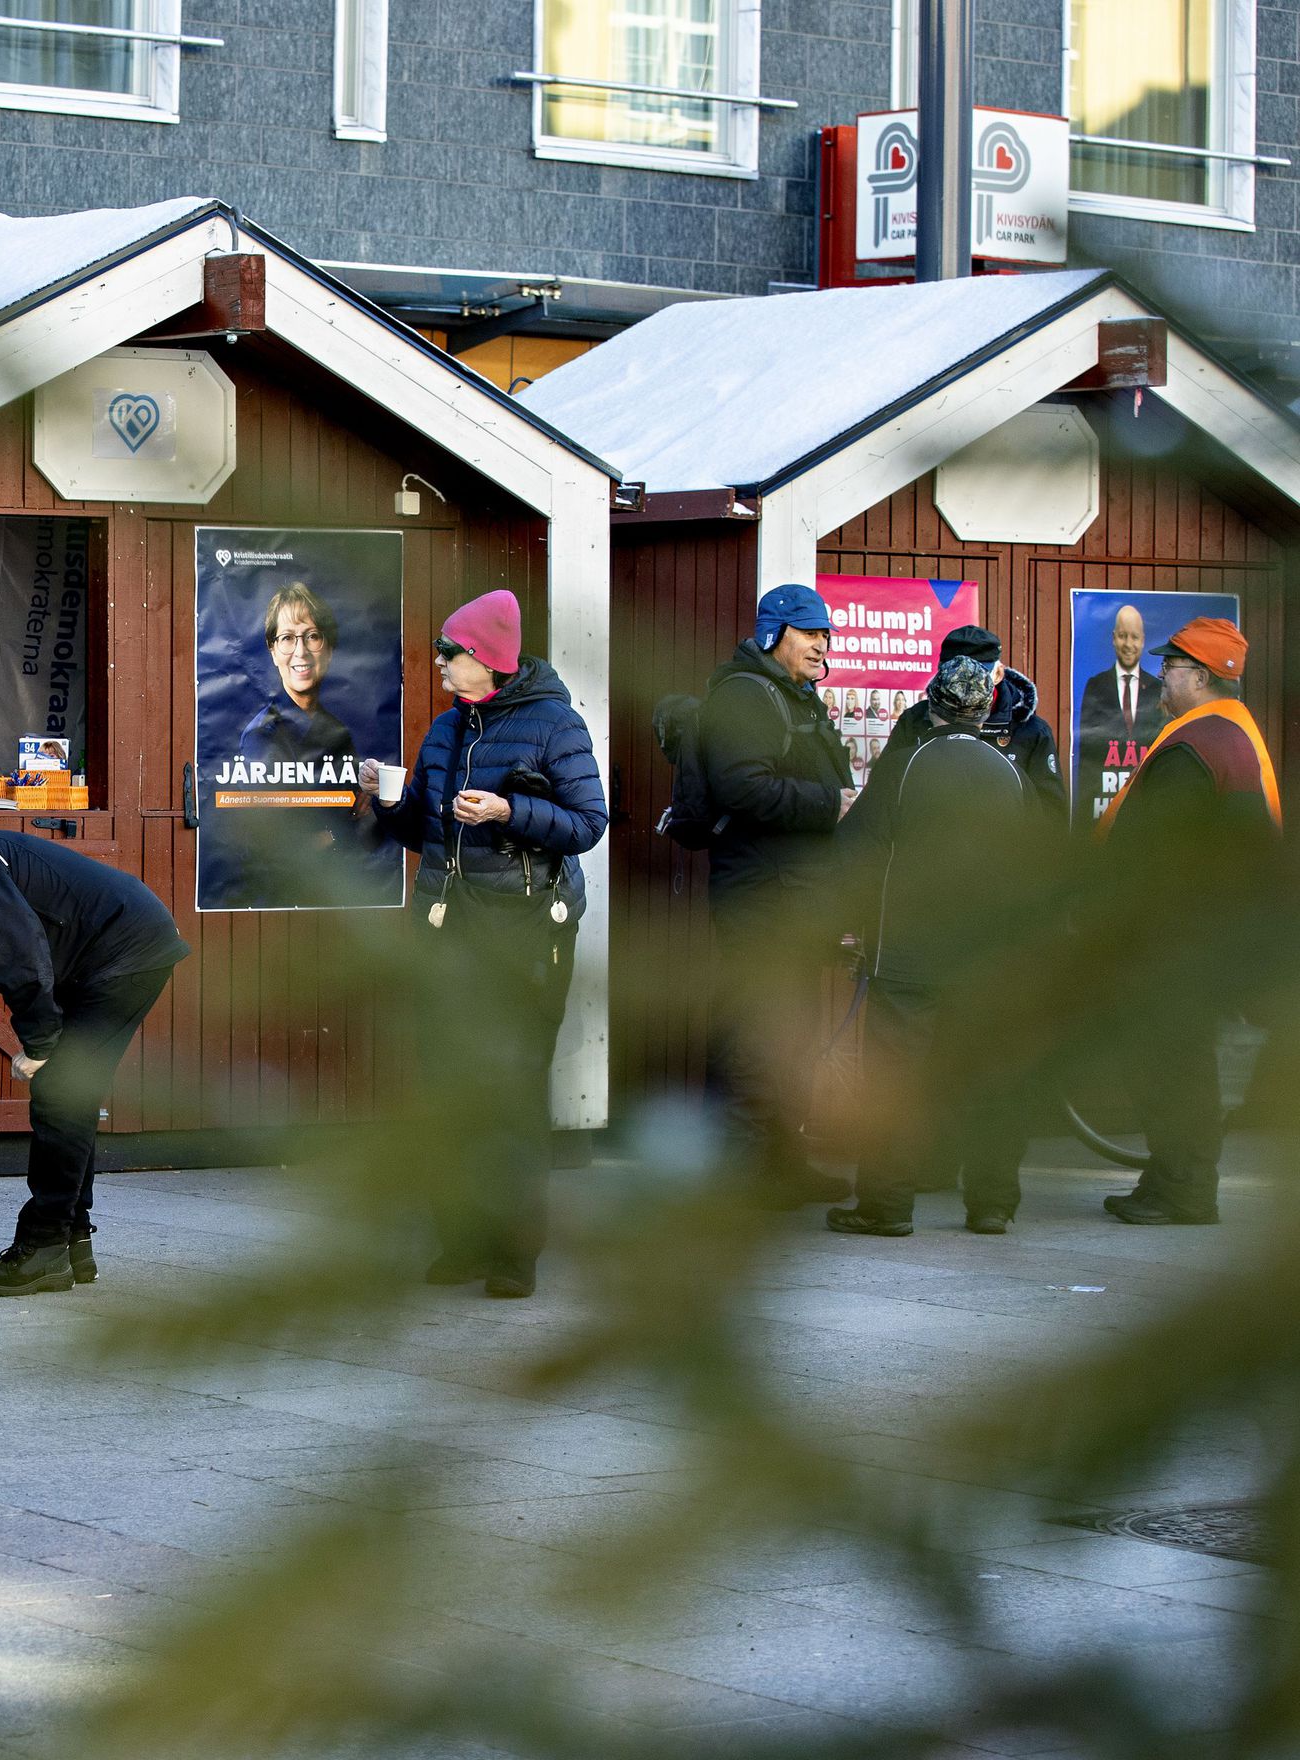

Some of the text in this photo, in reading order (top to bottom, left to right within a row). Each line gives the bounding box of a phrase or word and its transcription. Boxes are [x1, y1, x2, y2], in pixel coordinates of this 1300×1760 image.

[891, 212, 917, 225] KIVIS
[996, 211, 1055, 231] KIVISYDÄN
[891, 229, 917, 240] CAR PA
[996, 230, 1035, 245] CAR PARK
[22, 521, 58, 676] mokraterna
[830, 632, 933, 656] uominen
[867, 660, 877, 670] EI
[878, 660, 933, 673] HARVOILLE
[24, 742, 36, 753] 94
[215, 755, 368, 784] JÄRJEN ÄÄ
[252, 795, 290, 804] Suomeen
[291, 796, 351, 804] suunnanmuutos
